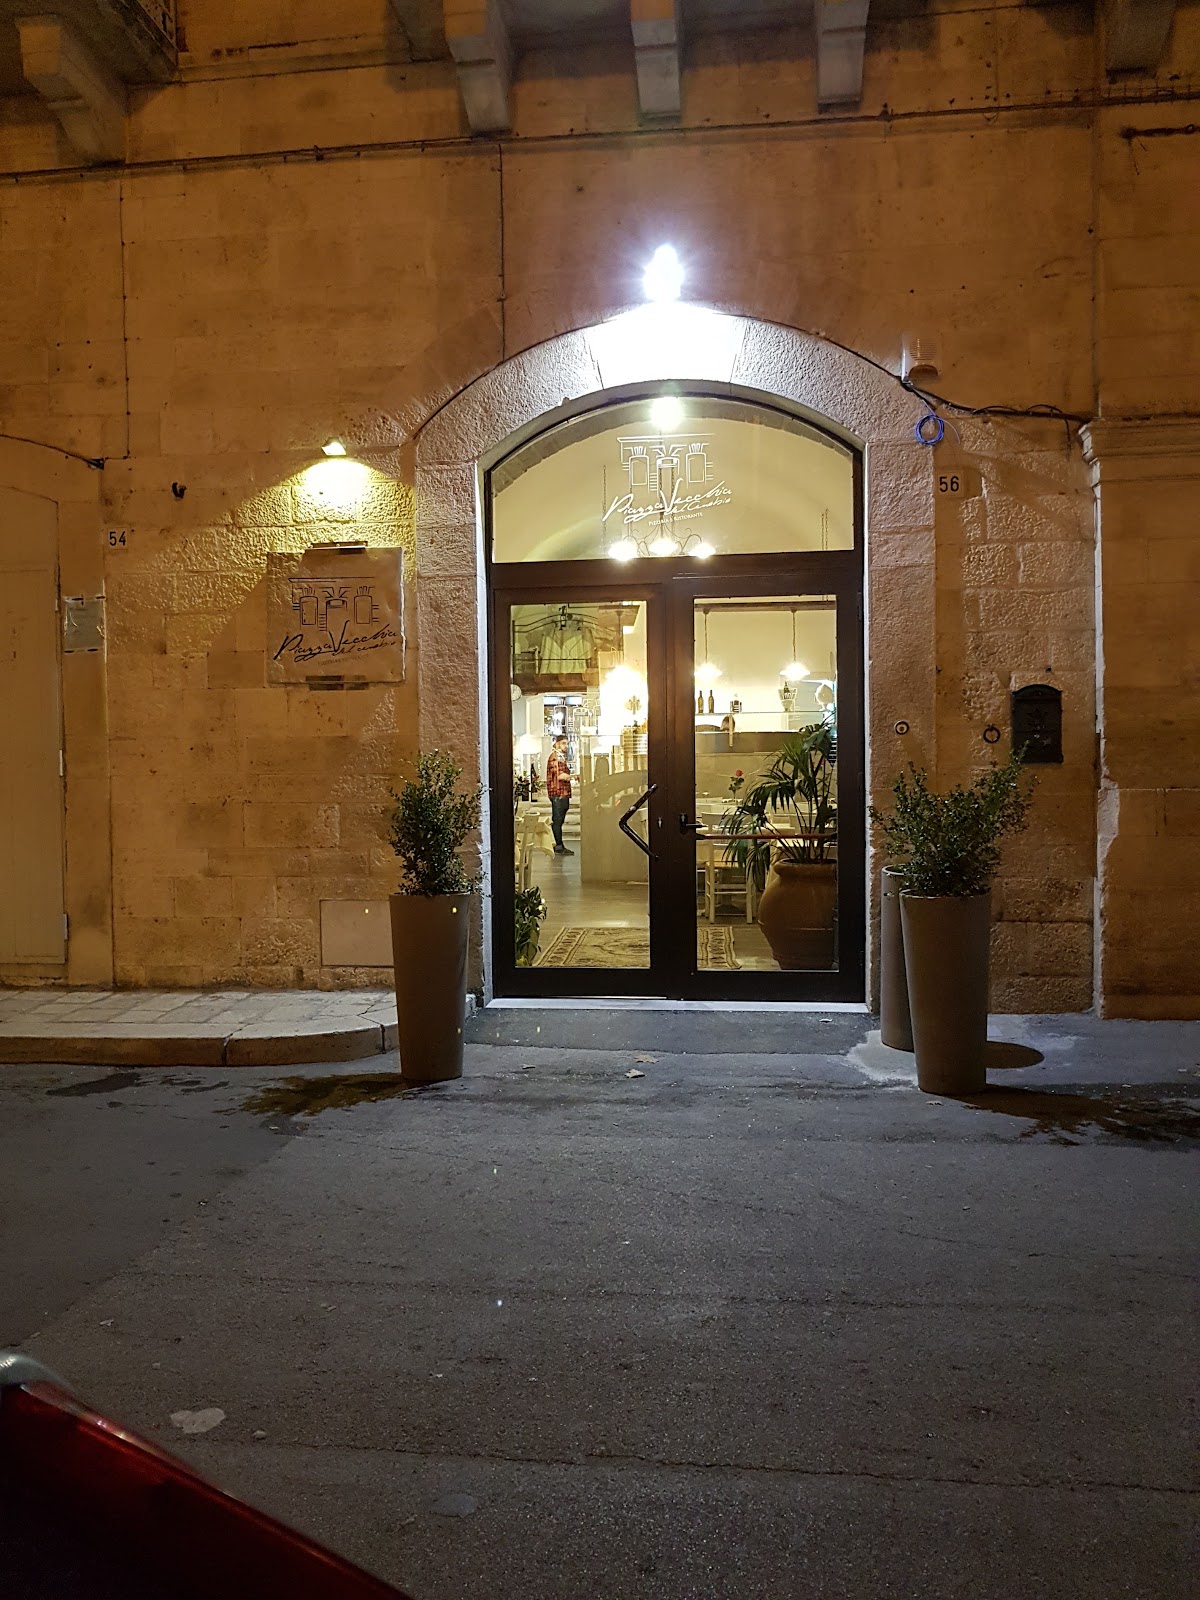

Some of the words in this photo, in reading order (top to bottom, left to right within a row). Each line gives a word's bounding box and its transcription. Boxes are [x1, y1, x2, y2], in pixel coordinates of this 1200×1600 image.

[939, 475, 959, 493] 56
[602, 494, 665, 524] Piazza
[660, 478, 733, 512] Vecchia
[109, 531, 126, 546] 54
[273, 634, 334, 663] Piazza
[328, 620, 398, 652] Vecchia
